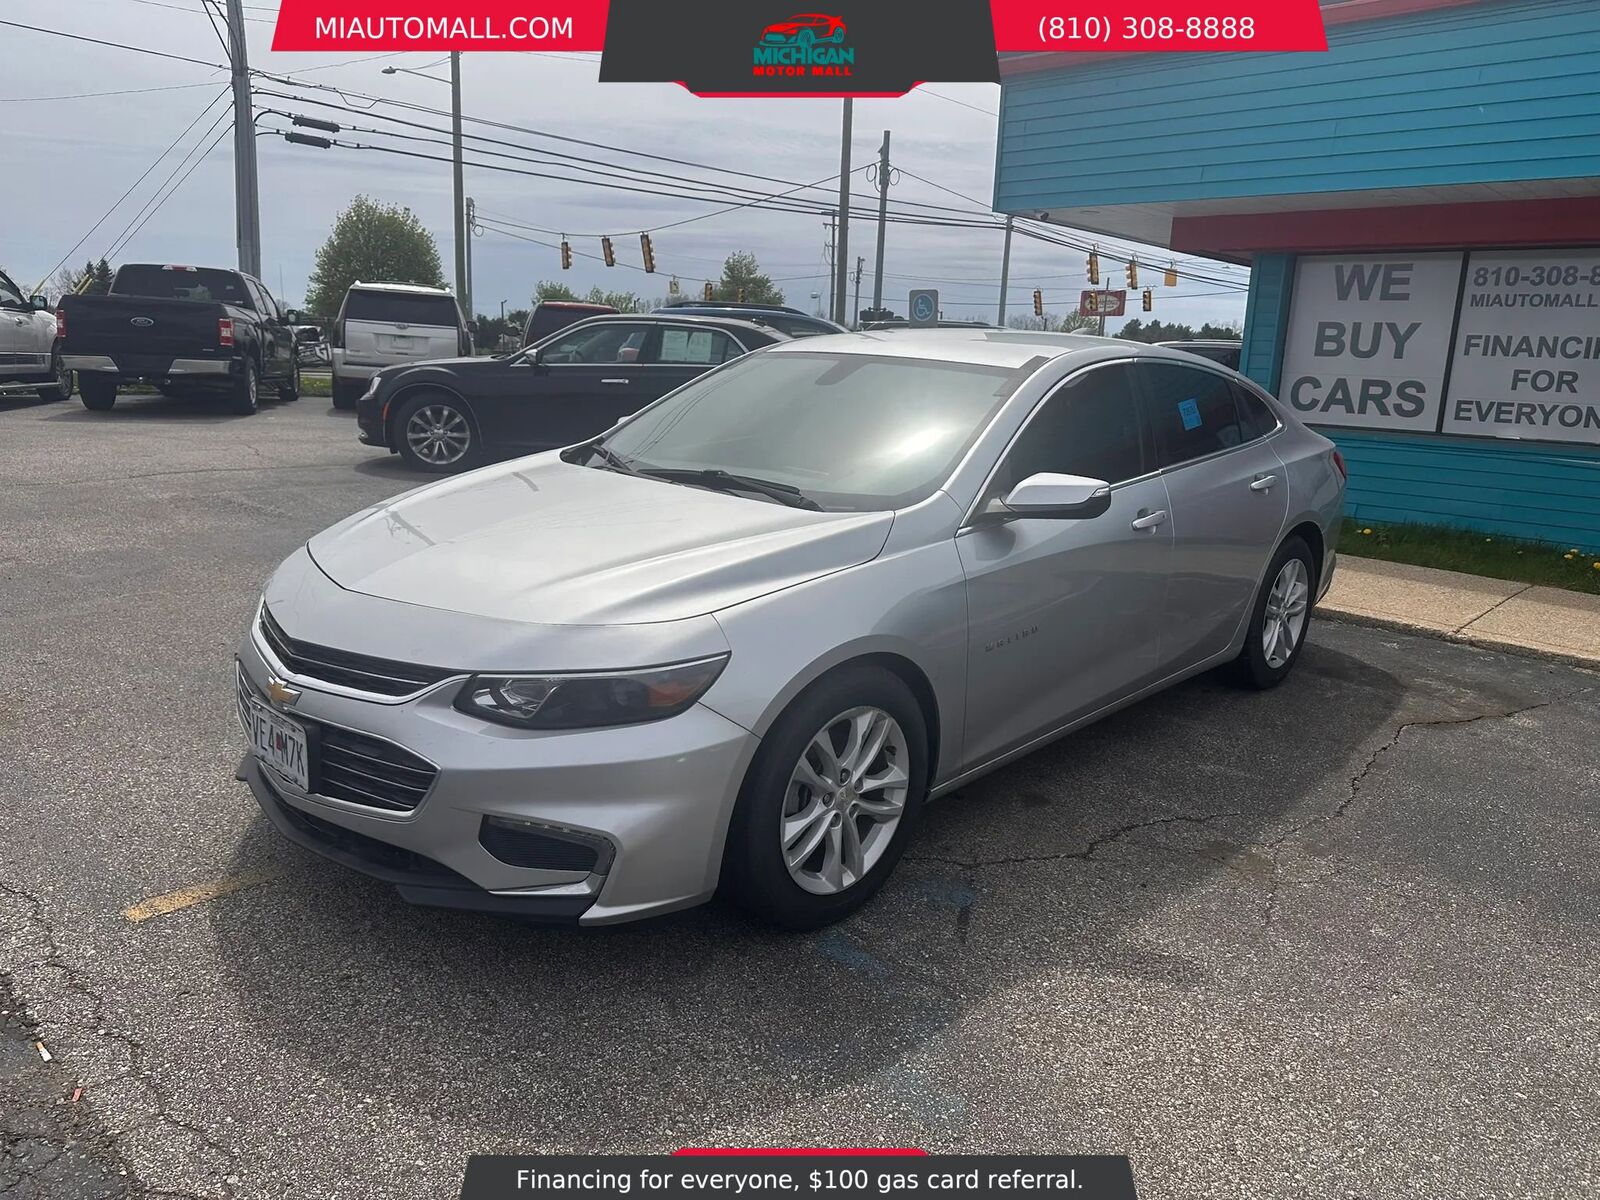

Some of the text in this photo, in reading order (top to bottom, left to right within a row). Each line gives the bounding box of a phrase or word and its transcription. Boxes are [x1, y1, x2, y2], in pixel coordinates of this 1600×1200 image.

[1333, 262, 1415, 302] WE
[1313, 321, 1423, 360] BUY
[1290, 375, 1427, 418] CARS
[1510, 369, 1579, 394] FOR
